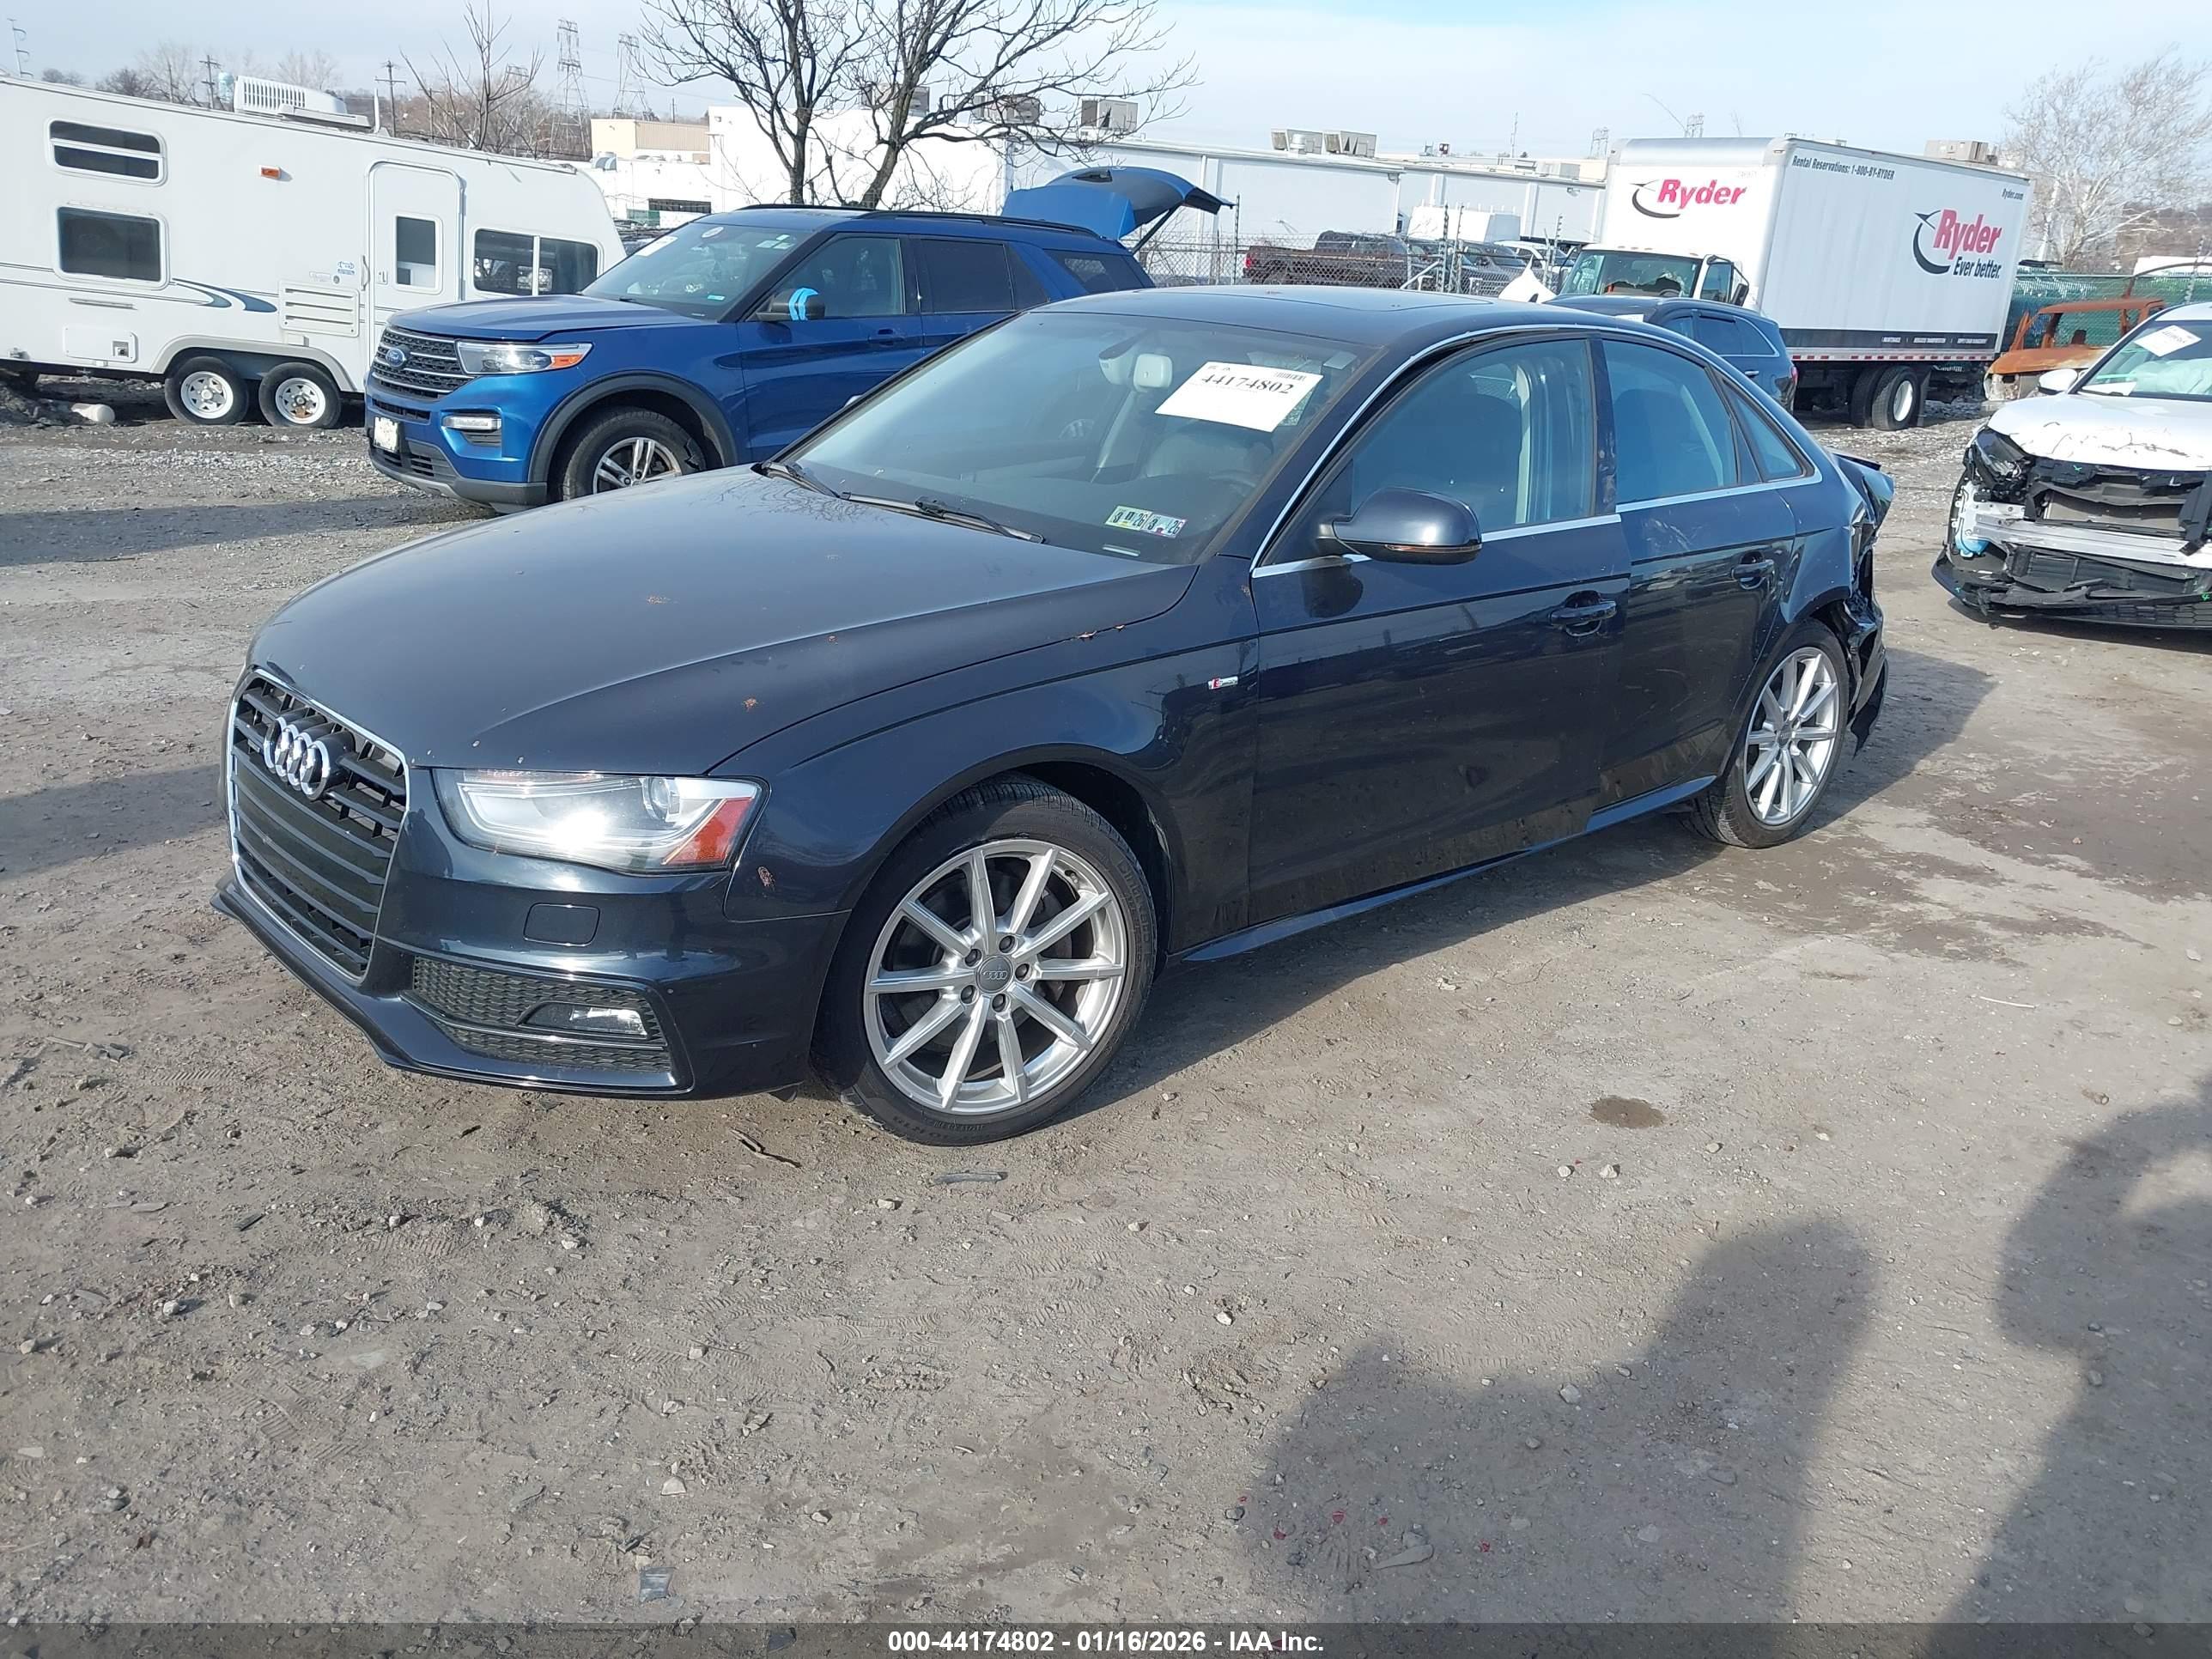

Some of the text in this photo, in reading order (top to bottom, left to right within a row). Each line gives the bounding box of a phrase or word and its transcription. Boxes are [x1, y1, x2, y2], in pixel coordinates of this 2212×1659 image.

[1792, 155, 1895, 180] Rental Reservations: 1-800-BY-RYDER
[1657, 179, 1747, 210] Ryder
[2002, 188, 2024, 200] Ryder.com
[1933, 209, 2002, 260] Ryder
[1953, 256, 2002, 279] Ever better.
[1201, 374, 1294, 394] 44174802
